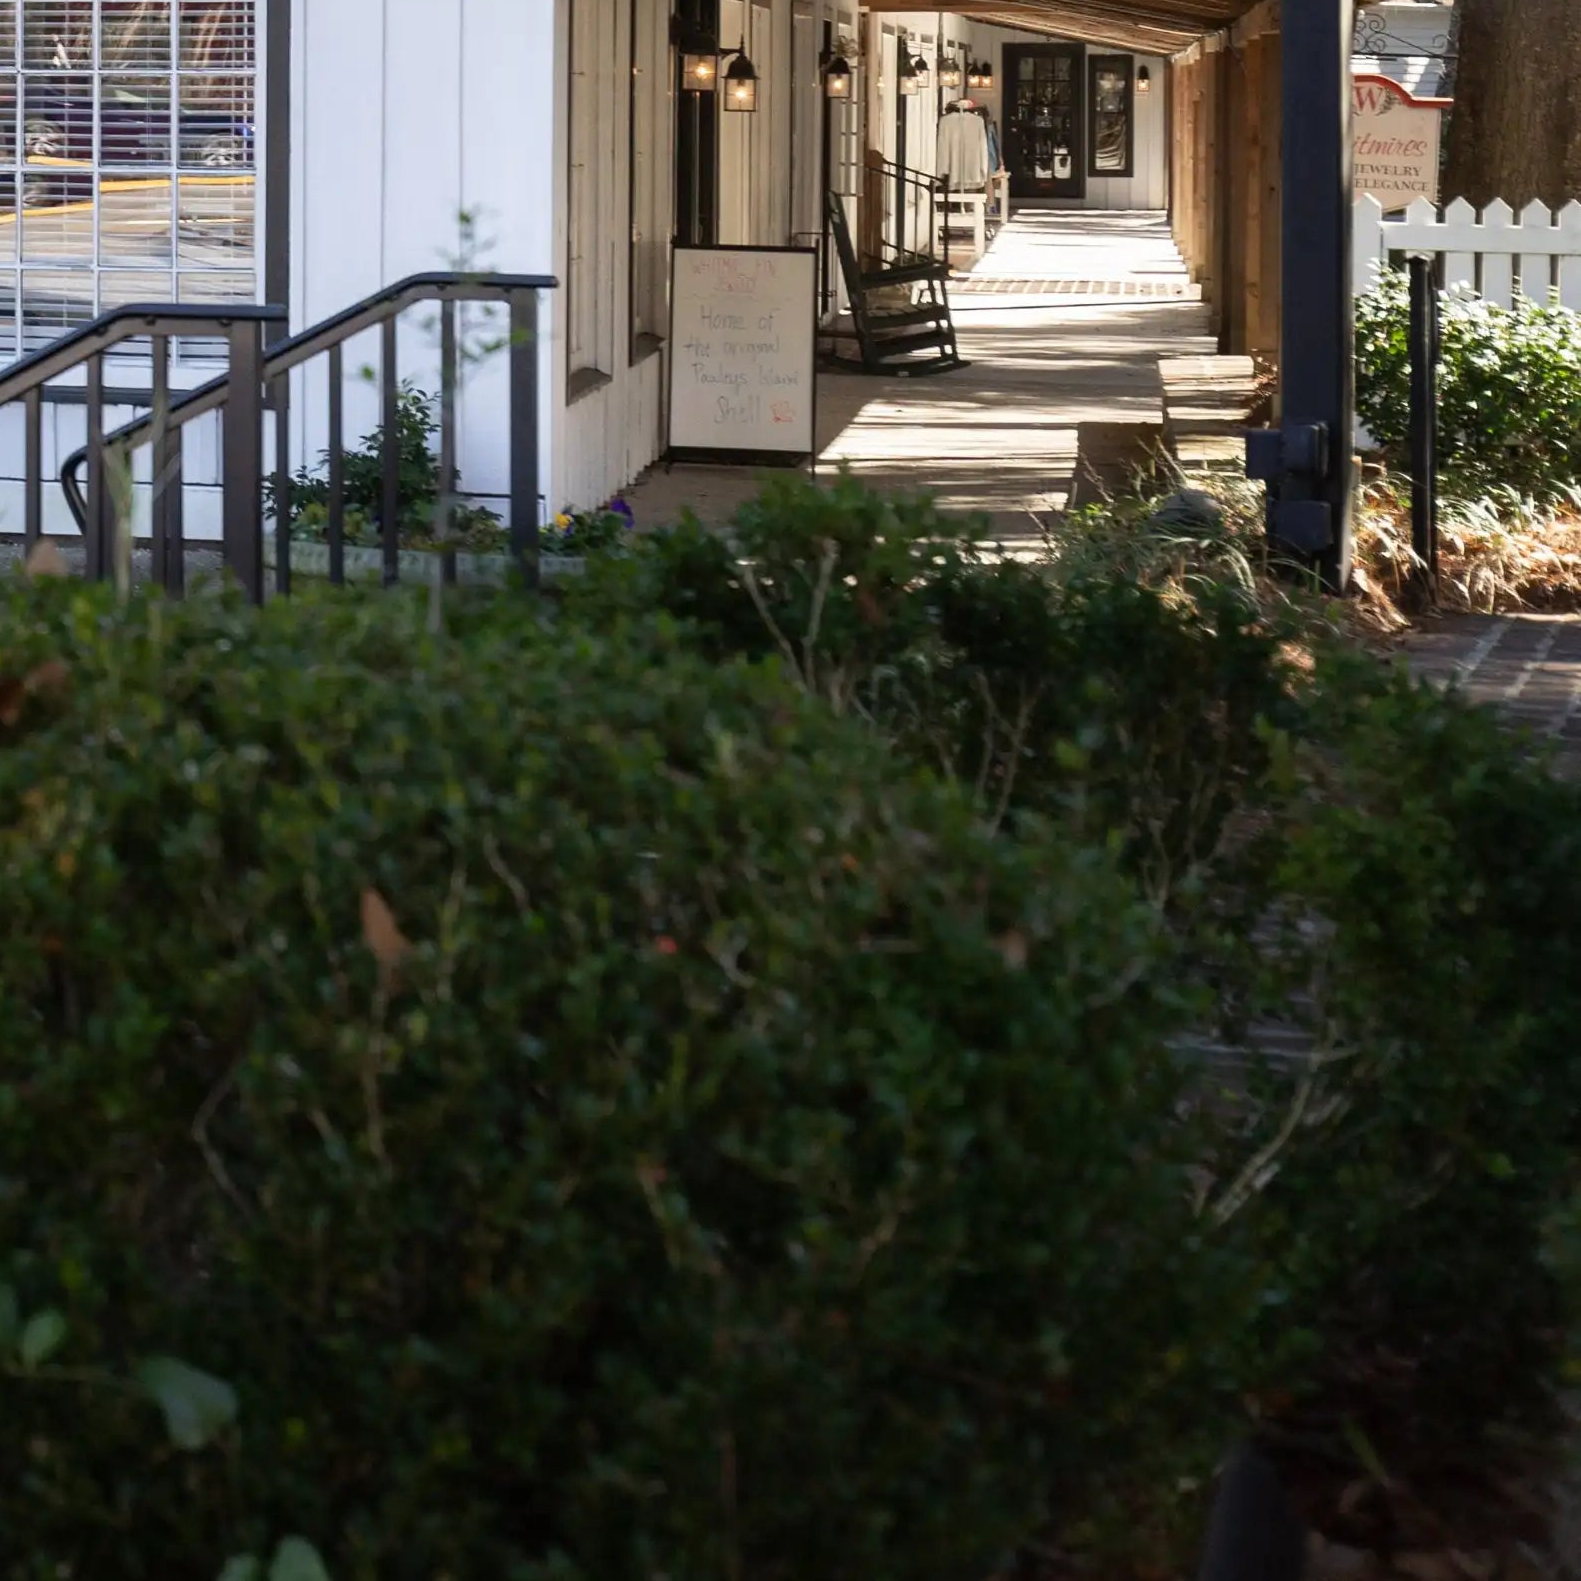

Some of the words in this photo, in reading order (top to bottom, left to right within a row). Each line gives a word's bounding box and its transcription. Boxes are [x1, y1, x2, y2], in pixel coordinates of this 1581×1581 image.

[1353, 87, 1383, 112] W
[1354, 133, 1428, 157] itmires
[1355, 178, 1431, 192] ELEGANCE
[699, 304, 748, 331] Home
[758, 307, 782, 332] of
[683, 333, 711, 358] the
[714, 394, 761, 424] Shell
